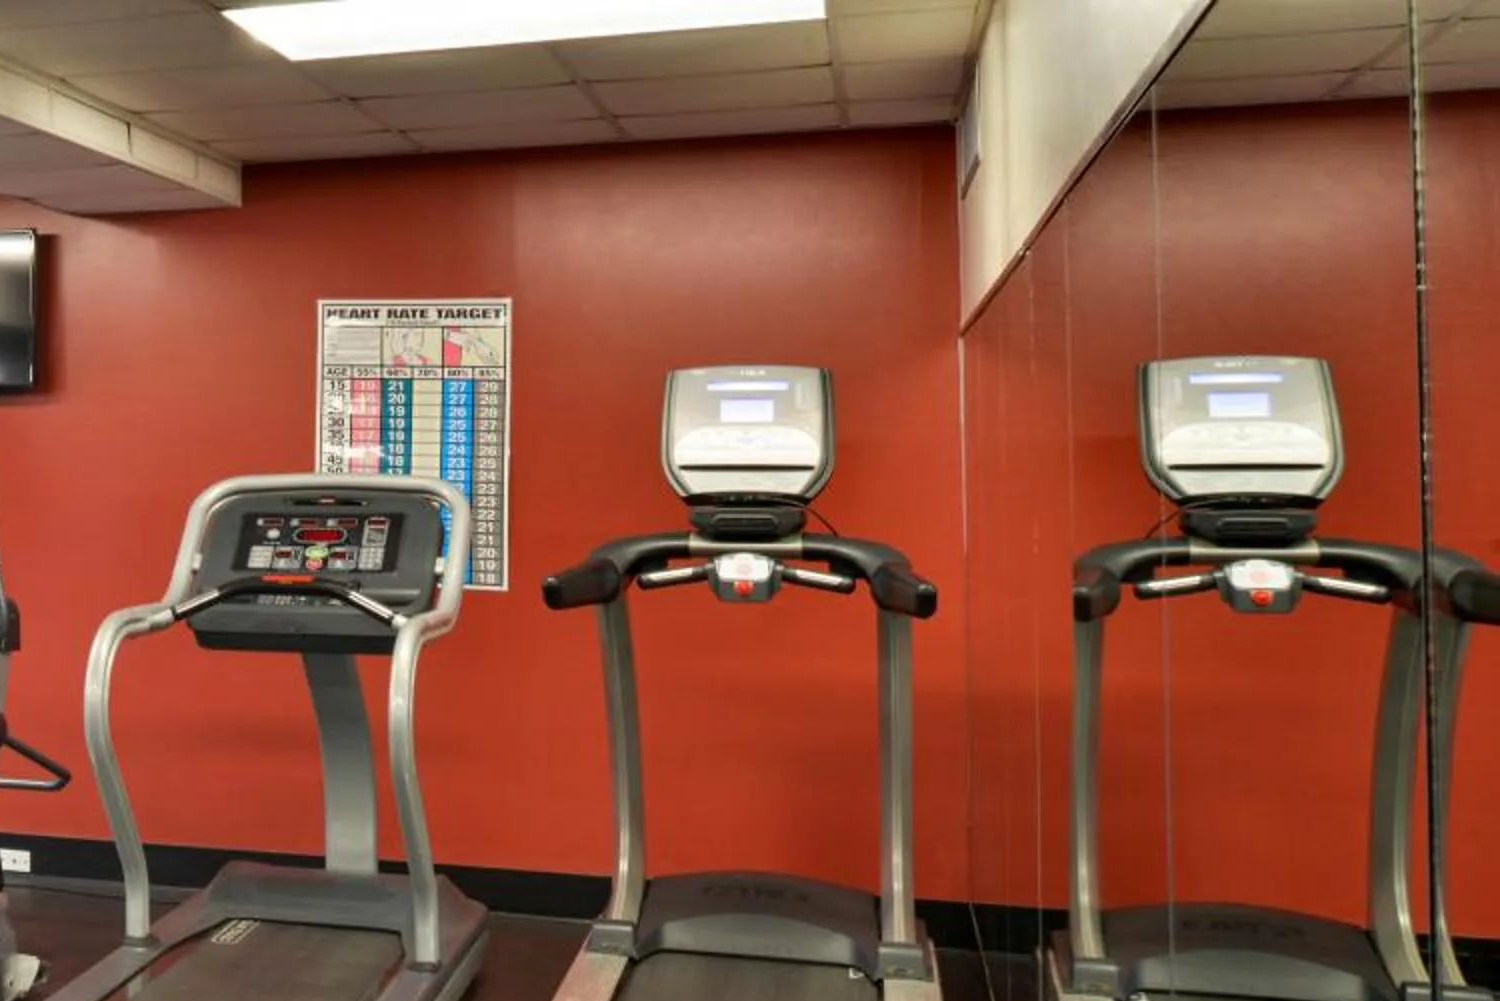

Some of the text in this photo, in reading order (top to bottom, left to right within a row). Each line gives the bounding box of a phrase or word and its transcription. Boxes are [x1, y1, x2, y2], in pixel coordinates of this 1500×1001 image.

[437, 308, 504, 319] TARGET
[449, 381, 467, 392] 27
[449, 394, 467, 404] 27
[478, 509, 496, 520] 22
[478, 522, 496, 533] 21
[478, 535, 496, 545] 21
[478, 548, 496, 559] 20
